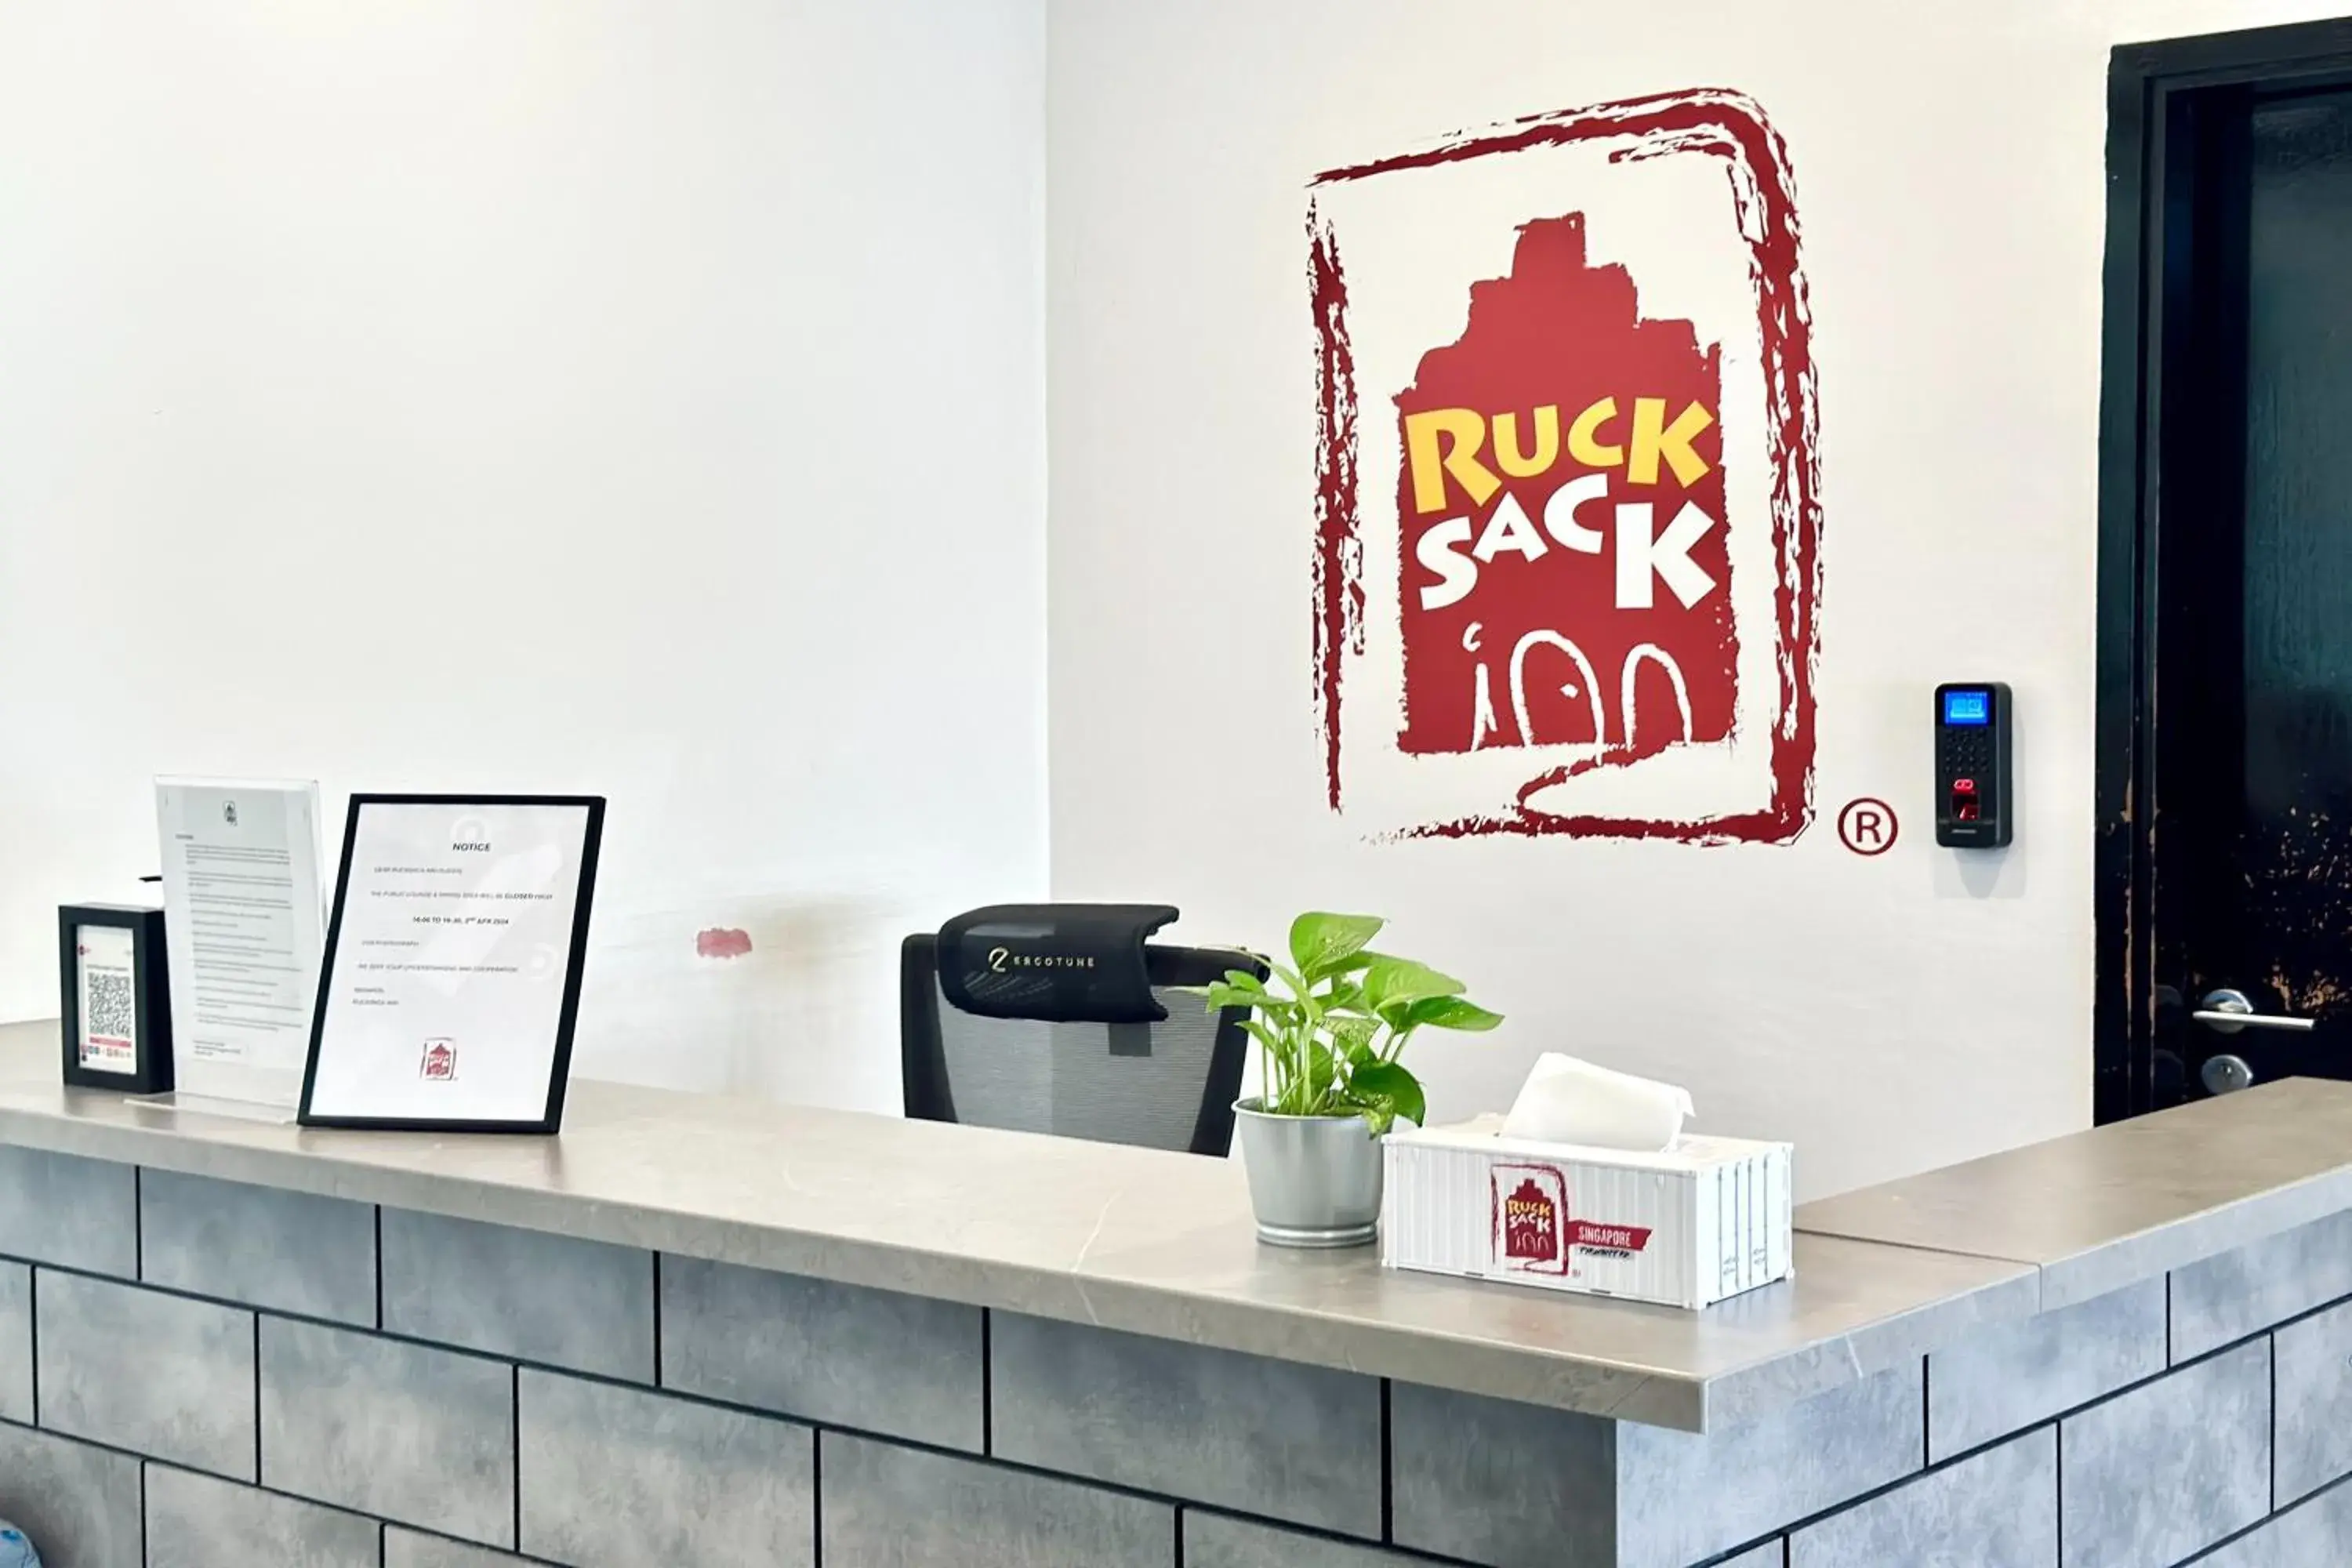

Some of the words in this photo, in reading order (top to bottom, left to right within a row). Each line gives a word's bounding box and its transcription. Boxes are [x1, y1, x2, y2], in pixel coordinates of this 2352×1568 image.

[1405, 396, 1714, 514] RUCK
[1416, 473, 1717, 611] SACK
[1463, 622, 1693, 765] inn
[452, 843, 492, 851] NOTICE
[1508, 1199, 1552, 1217] RUCK
[1509, 1213, 1552, 1233] SACK
[1578, 1225, 1632, 1247] SINGAPORE
